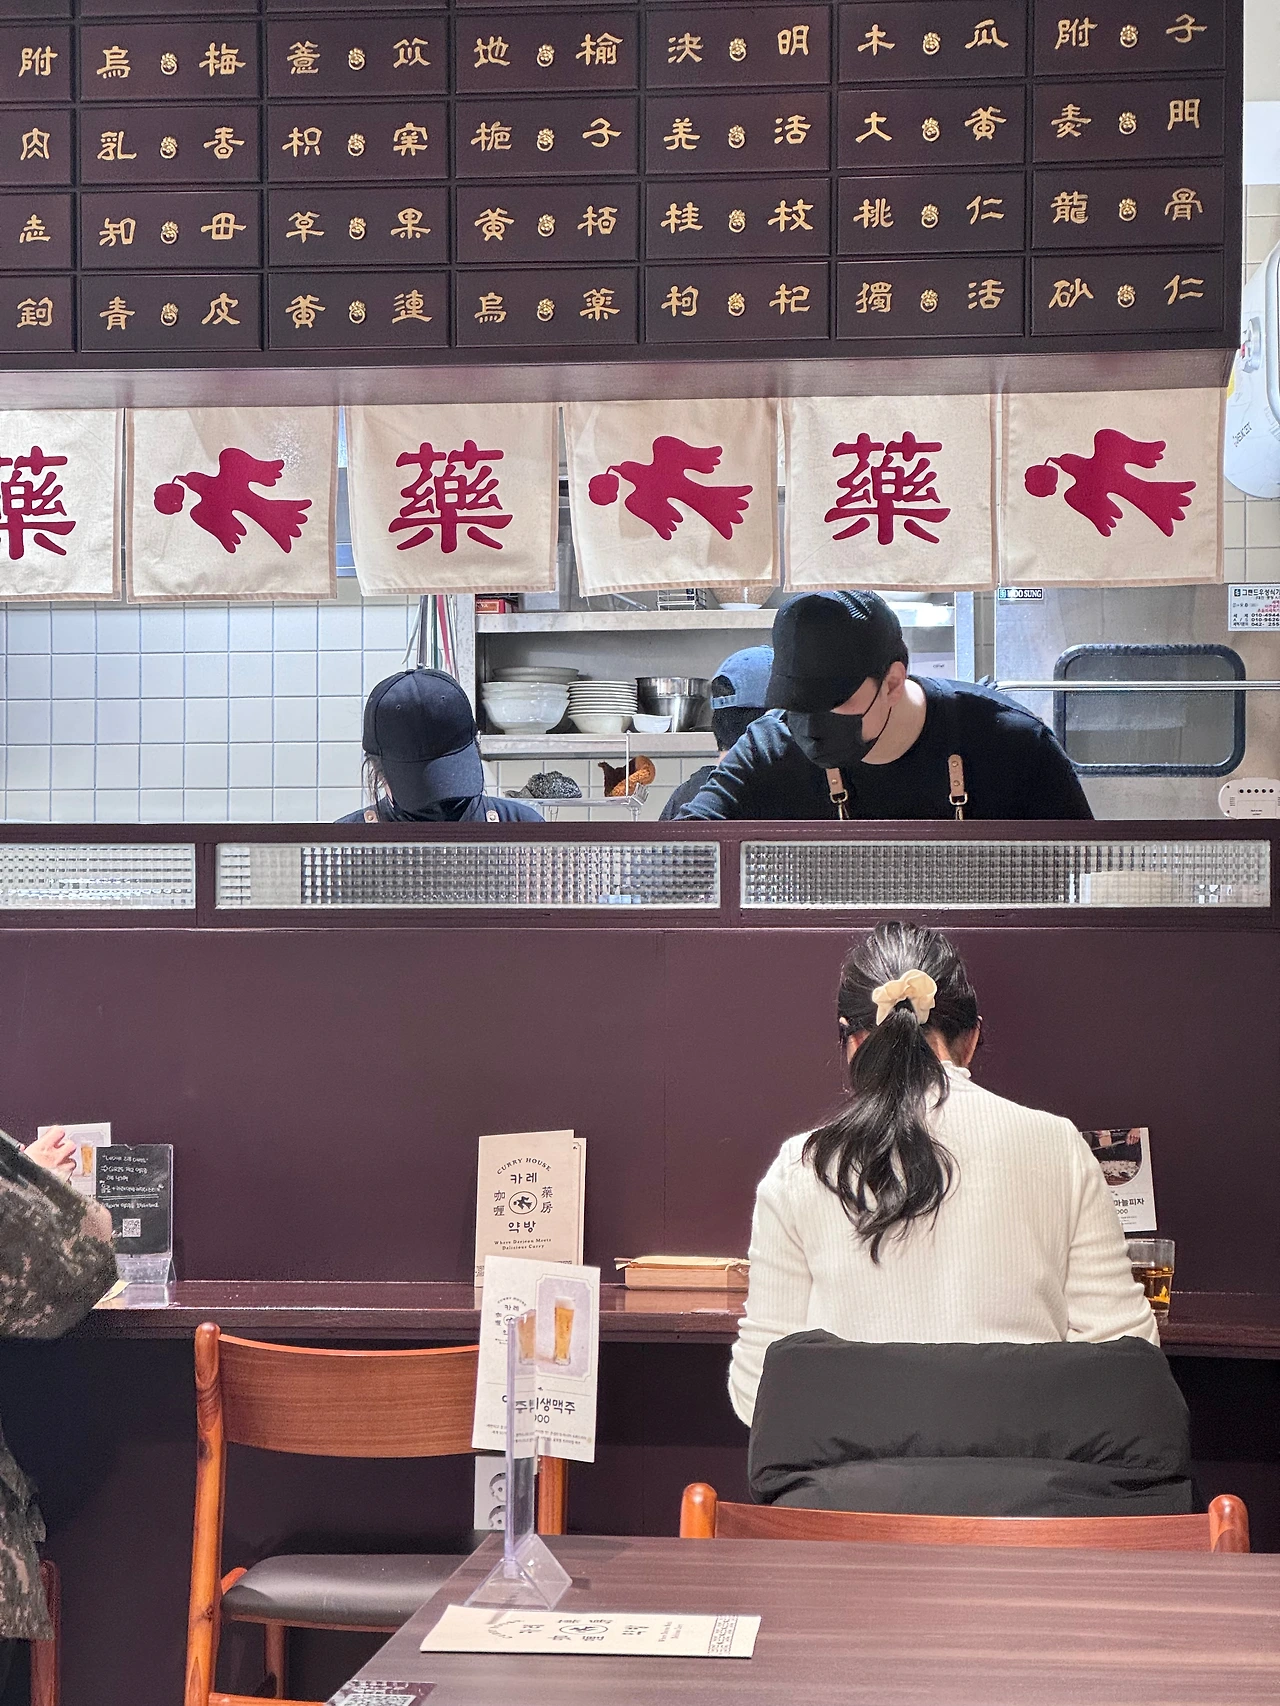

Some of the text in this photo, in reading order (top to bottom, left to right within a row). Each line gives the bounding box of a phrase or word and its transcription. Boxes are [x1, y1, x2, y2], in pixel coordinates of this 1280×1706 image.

[778, 25, 809, 54] 明
[859, 19, 1007, 53] 木 瓜
[1056, 15, 1204, 48] 附 子
[20, 47, 56, 74] 附
[201, 43, 244, 75] 梅
[475, 37, 508, 66] 地
[776, 115, 809, 143] 活
[858, 112, 891, 141] 大
[1169, 99, 1199, 129] 門
[22, 128, 49, 158] 肉
[99, 128, 243, 159] 乳 香
[284, 128, 321, 154] 枳
[584, 118, 620, 146] 子
[662, 200, 812, 232] 桂 枝
[855, 197, 1002, 226] 桃 仁
[1054, 189, 1202, 223] 龍 骨
[21, 216, 49, 241] 志
[101, 218, 135, 244] 知
[288, 208, 429, 240] 草 果
[663, 284, 809, 315] 枸 杞
[857, 280, 1002, 312] 獨 活
[1050, 276, 1202, 306] 砂 仁
[203, 293, 238, 323] 皮
[394, 291, 429, 322] 連
[390, 441, 511, 552] 藥
[826, 433, 949, 543] 藥
[1024, 589, 1042, 598] SUNG
[496, 1157, 552, 1175] CURRY HOUSE
[510, 1172, 538, 1184] 카레
[508, 1220, 537, 1234] 약방
